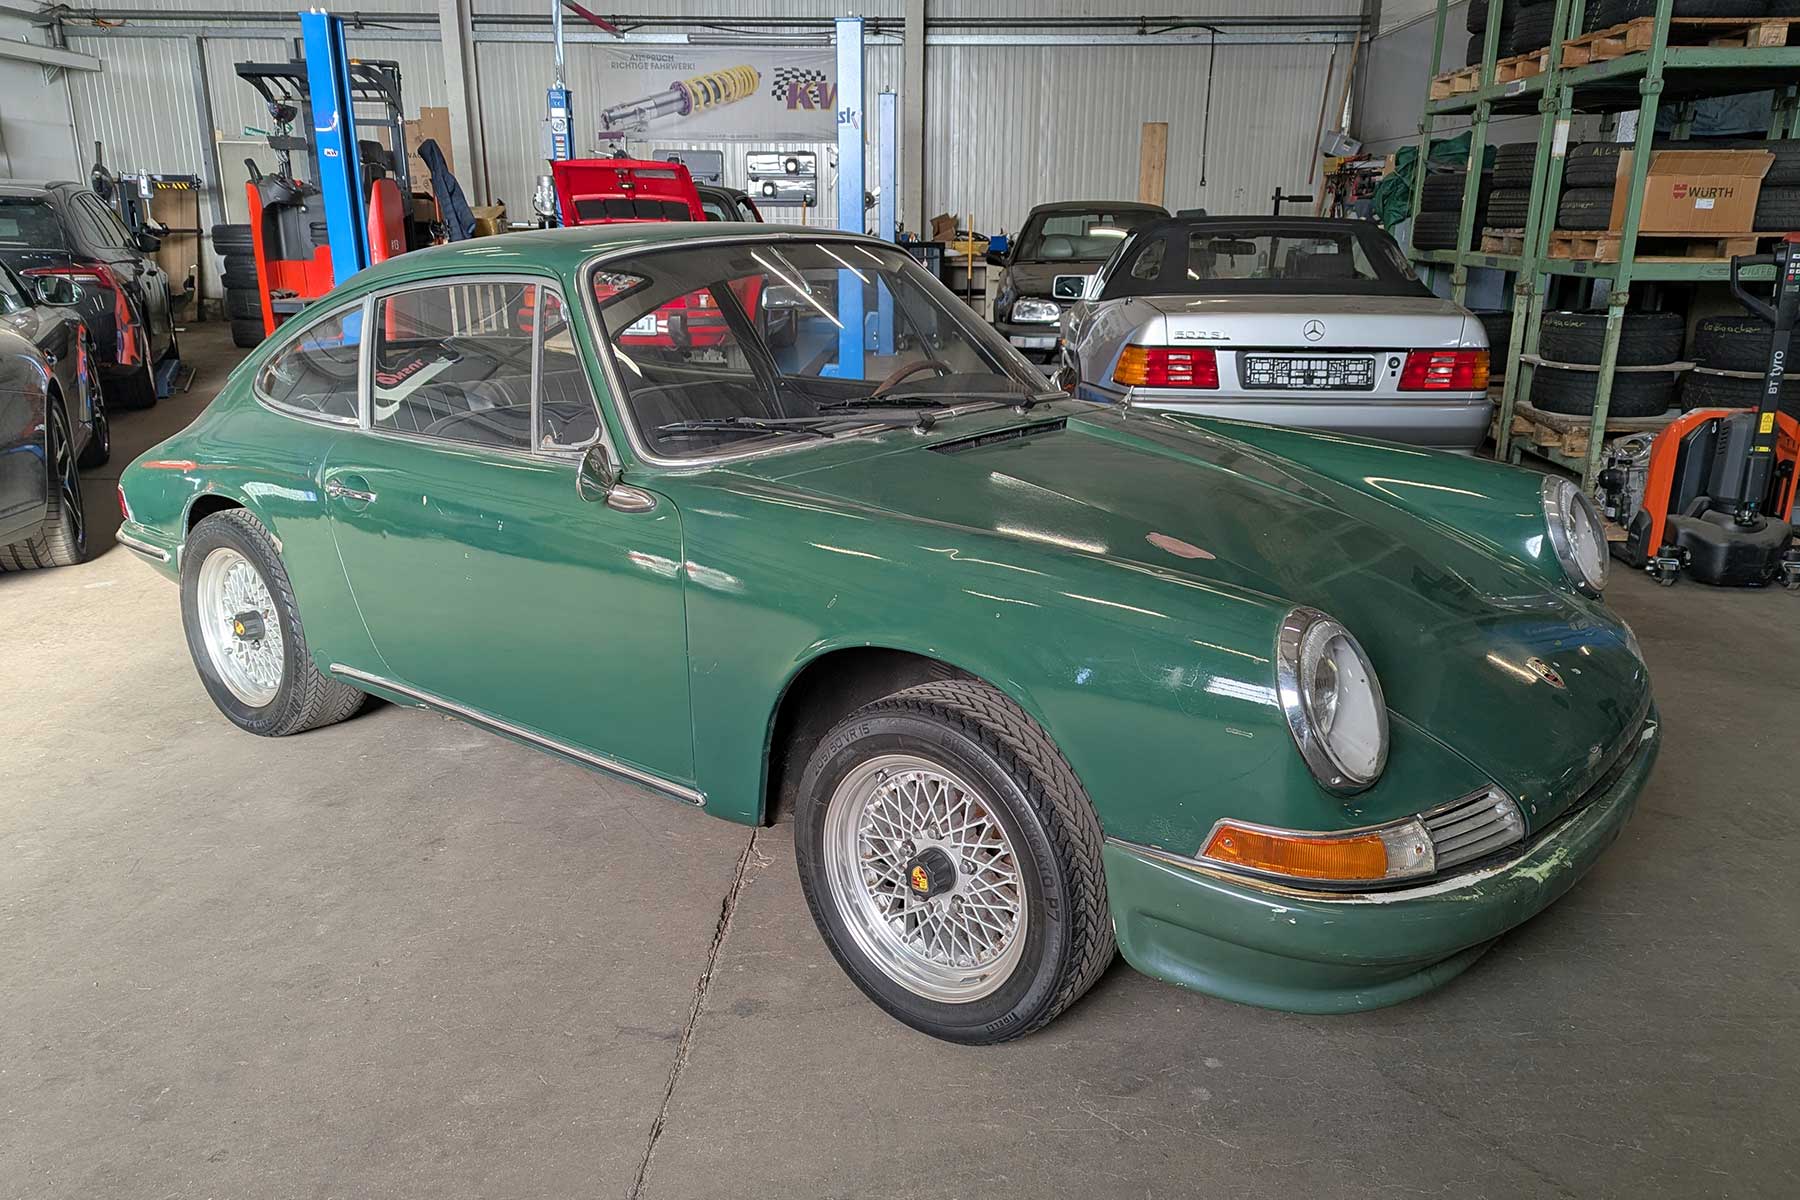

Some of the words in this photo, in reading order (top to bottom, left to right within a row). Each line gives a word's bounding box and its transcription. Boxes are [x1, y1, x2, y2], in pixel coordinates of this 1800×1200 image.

[611, 62, 649, 70] RICHTIGE
[650, 62, 696, 71] FAHRWERK!
[1689, 186, 1734, 198] WÜRTH
[1770, 350, 1784, 376] tyro
[1768, 380, 1779, 394] BT
[1045, 897, 1060, 922] P7
[985, 1011, 1022, 1033] PIRELLI
